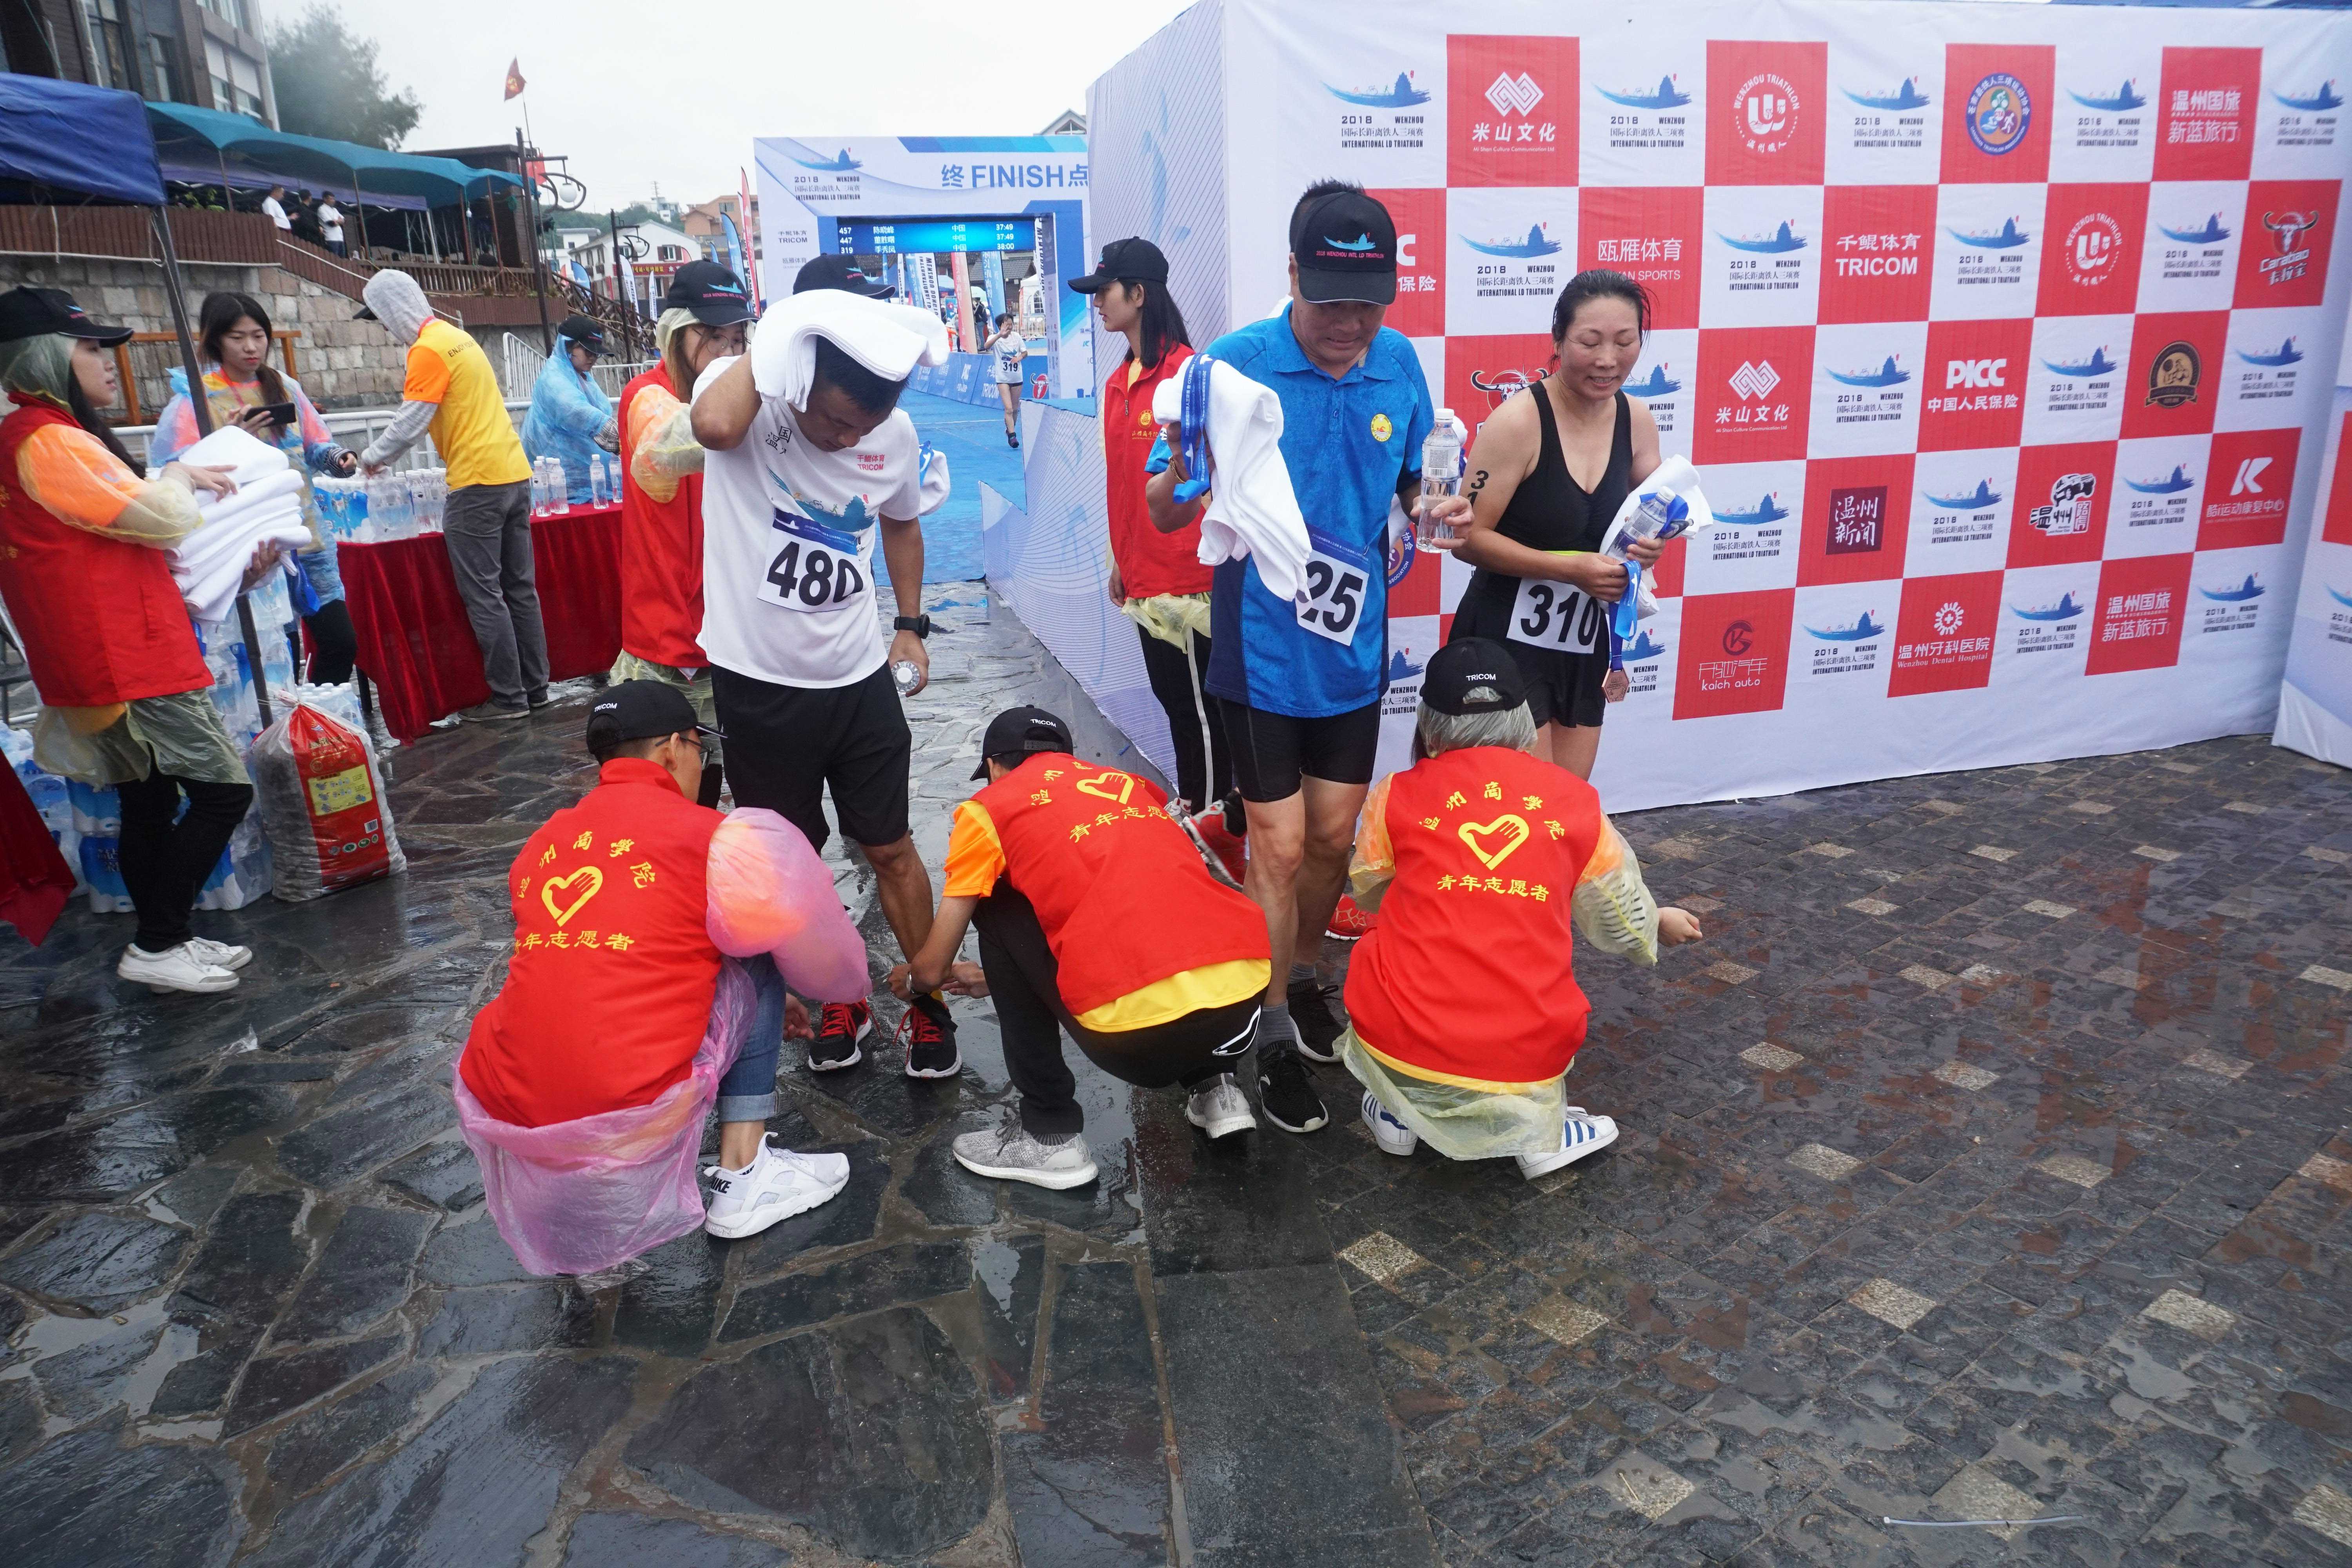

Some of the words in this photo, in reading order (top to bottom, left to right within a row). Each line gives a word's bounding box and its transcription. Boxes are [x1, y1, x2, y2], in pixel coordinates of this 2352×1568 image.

[1733, 74, 1764, 110] WENZHOU
[1767, 74, 1800, 110] TRIATHLON
[2171, 90, 2241, 112] 温州国旅
[1342, 116, 1372, 124] 2018
[1611, 116, 1638, 125] 2018
[1855, 117, 1880, 125] 2018
[1341, 127, 1424, 137] 国际长距离铁人三项赛
[1472, 122, 1556, 142] 米山文化
[1610, 128, 1684, 137] 国际长距离铁人三项赛
[941, 164, 965, 188] 终
[971, 165, 1063, 188] FINISH
[1067, 164, 1088, 187] 点
[2065, 213, 2095, 247] WENZHOU
[1836, 233, 1921, 251] 千鲲体育
[1959, 256, 1983, 264] 2018
[2258, 249, 2310, 273] Carabao
[1477, 266, 1506, 274] 2018
[1527, 265, 1555, 273] WENZHOU
[1835, 257, 1918, 276] TRICOM
[1477, 276, 1554, 286] 国际长距离铁人三项赛
[1639, 270, 1680, 281] SPORTS
[1730, 271, 1800, 280] 国际长距离铁人三项赛
[1477, 289, 1517, 297] INTERNATIONAL
[1526, 287, 1553, 296] TRIATHLON
[1730, 283, 1765, 291] INTERNATIONAL
[1003, 361, 1018, 372] 319
[1945, 358, 2007, 390] PICC
[2051, 383, 2073, 392] 2018
[1838, 394, 1862, 403] 2018
[1927, 394, 2019, 413] 中国人民保险
[1649, 403, 1674, 411] WENZHOU
[1837, 404, 1902, 414] 国际长距离铁人三项赛
[1715, 404, 1790, 424] 米山文化
[1837, 415, 1870, 423] INTERNATIONAL
[1878, 413, 1901, 421] TRIATHLON
[857, 454, 885, 463] 千鲲体育
[1835, 495, 1878, 522] 温州
[2132, 500, 2153, 508] 2018
[1934, 516, 1956, 524] 2018
[1973, 514, 1994, 522] WENZHOU
[1714, 532, 1740, 541] 2018
[1835, 521, 1876, 546] 新闻
[1713, 539, 1781, 551] 国际长距离铁人三项赛
[1932, 535, 1963, 544] INTERNATIONAL
[1713, 551, 1748, 561] INTERNATIONAL
[1755, 549, 1779, 558] TRIATHLON
[767, 541, 864, 606] 480
[1388, 561, 1409, 584] SSOCIATION
[2106, 592, 2171, 615] 温州国旅
[1521, 584, 1600, 646] 310
[2019, 628, 2041, 636] 2018
[2102, 617, 2168, 642] 新蓝旅行
[1814, 648, 1838, 656] 2018
[1897, 637, 1990, 660] 温州牙科医院
[1813, 654, 1876, 667] 国际长距离铁人三项赛
[1897, 659, 1928, 669] Wenzhou
[1932, 656, 1955, 665] Dental
[1958, 653, 1987, 663] Hospital
[1812, 665, 1845, 675] INTERNATIONAL
[1852, 663, 1874, 672] TRIATHLON
[1466, 673, 1496, 682] TRICOM
[1390, 686, 1417, 694] WENZHOU
[1632, 684, 1656, 693] TRIATHLON
[1702, 679, 1730, 691] kaich
[1735, 678, 1760, 688] auto
[594, 702, 618, 713] TRICOM
[1389, 706, 1416, 715] TRIATHLON
[1030, 718, 1056, 728] TRICOM
[1436, 873, 1550, 903] 青年志愿者
